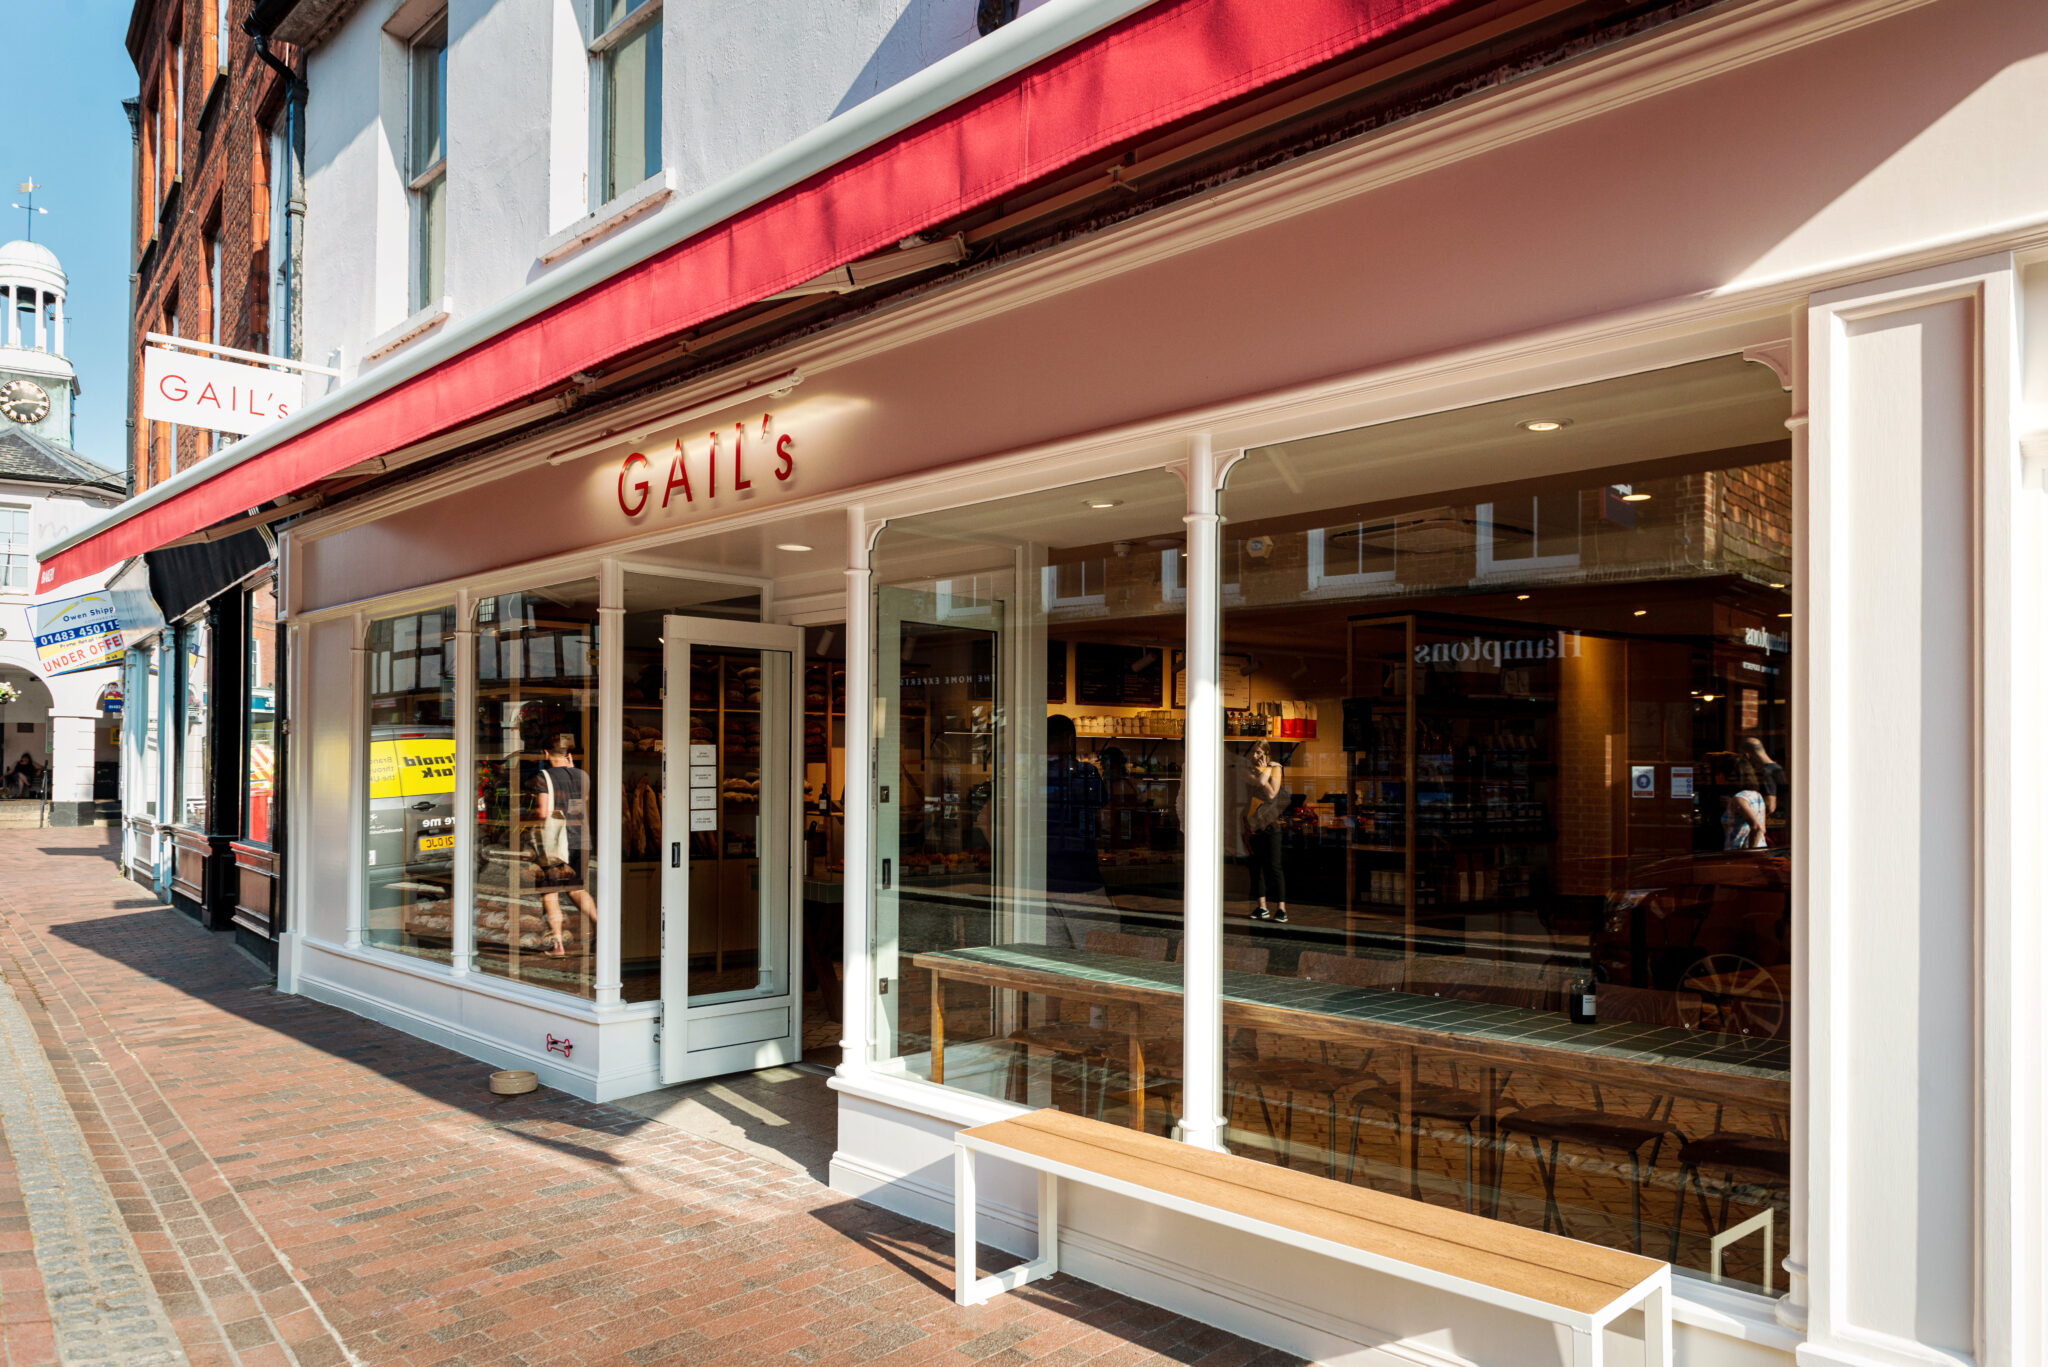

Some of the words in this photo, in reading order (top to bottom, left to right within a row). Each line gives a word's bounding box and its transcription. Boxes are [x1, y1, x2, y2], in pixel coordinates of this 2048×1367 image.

[617, 412, 793, 517] GAIL's
[62, 612, 88, 623] Owen
[40, 630, 76, 646] 01483
[42, 648, 87, 673] UNDER
